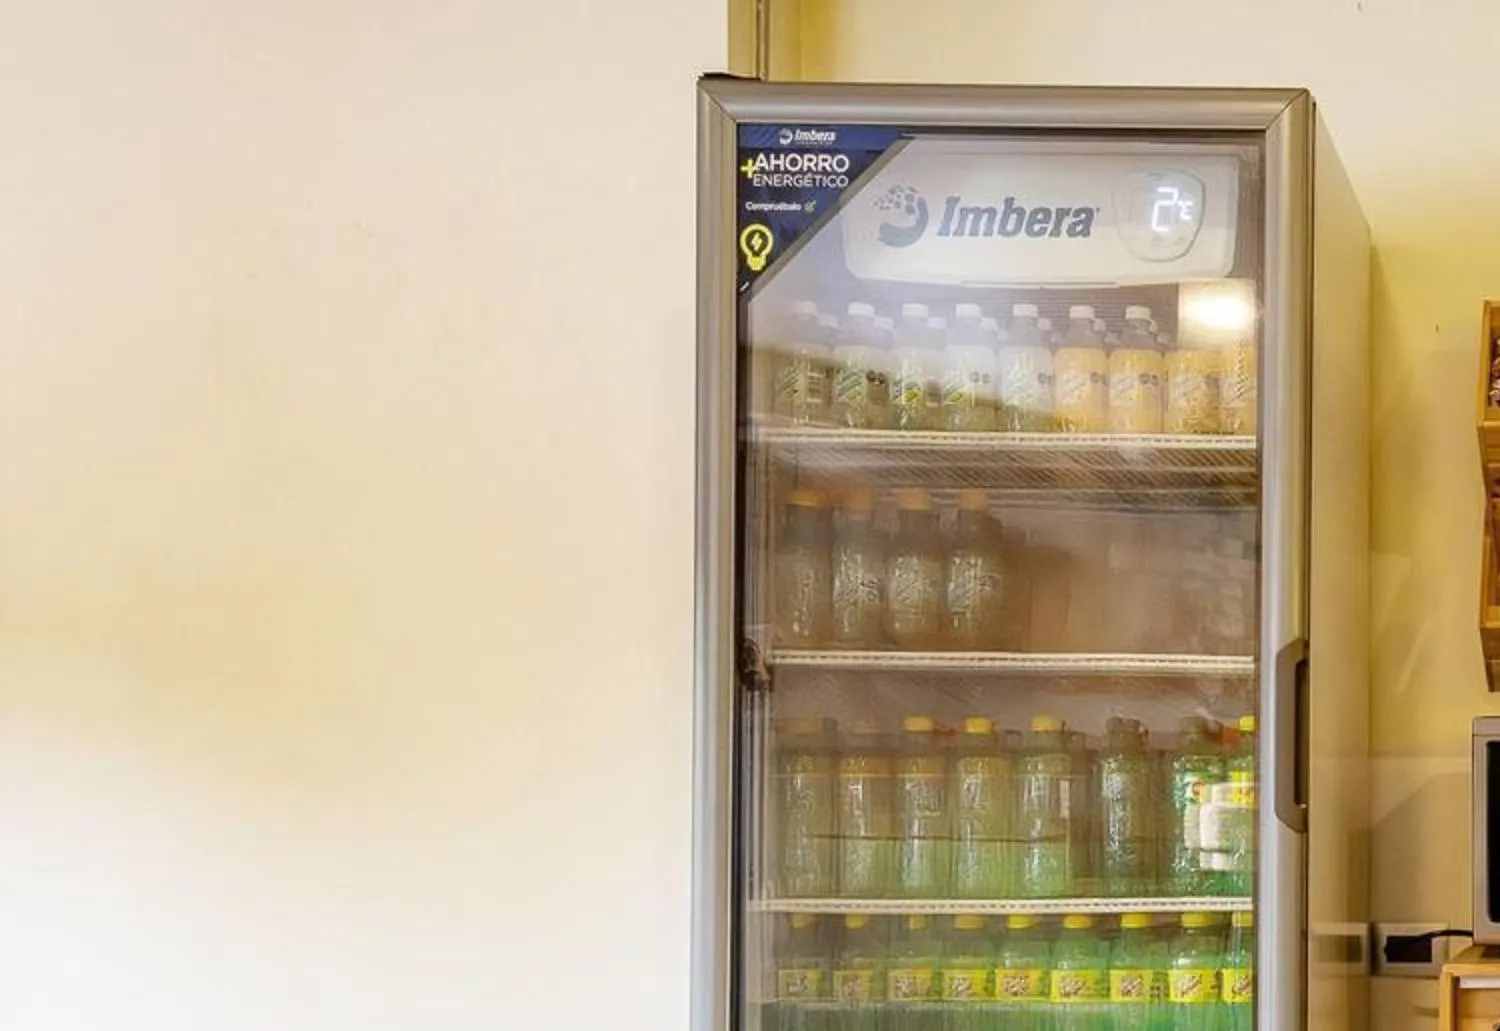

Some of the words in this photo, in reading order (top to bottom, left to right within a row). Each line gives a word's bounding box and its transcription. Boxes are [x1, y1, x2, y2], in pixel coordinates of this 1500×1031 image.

[794, 130, 837, 142] Imbera
[753, 173, 849, 188] ENERGÉTICO
[937, 195, 1095, 238] Imbera
